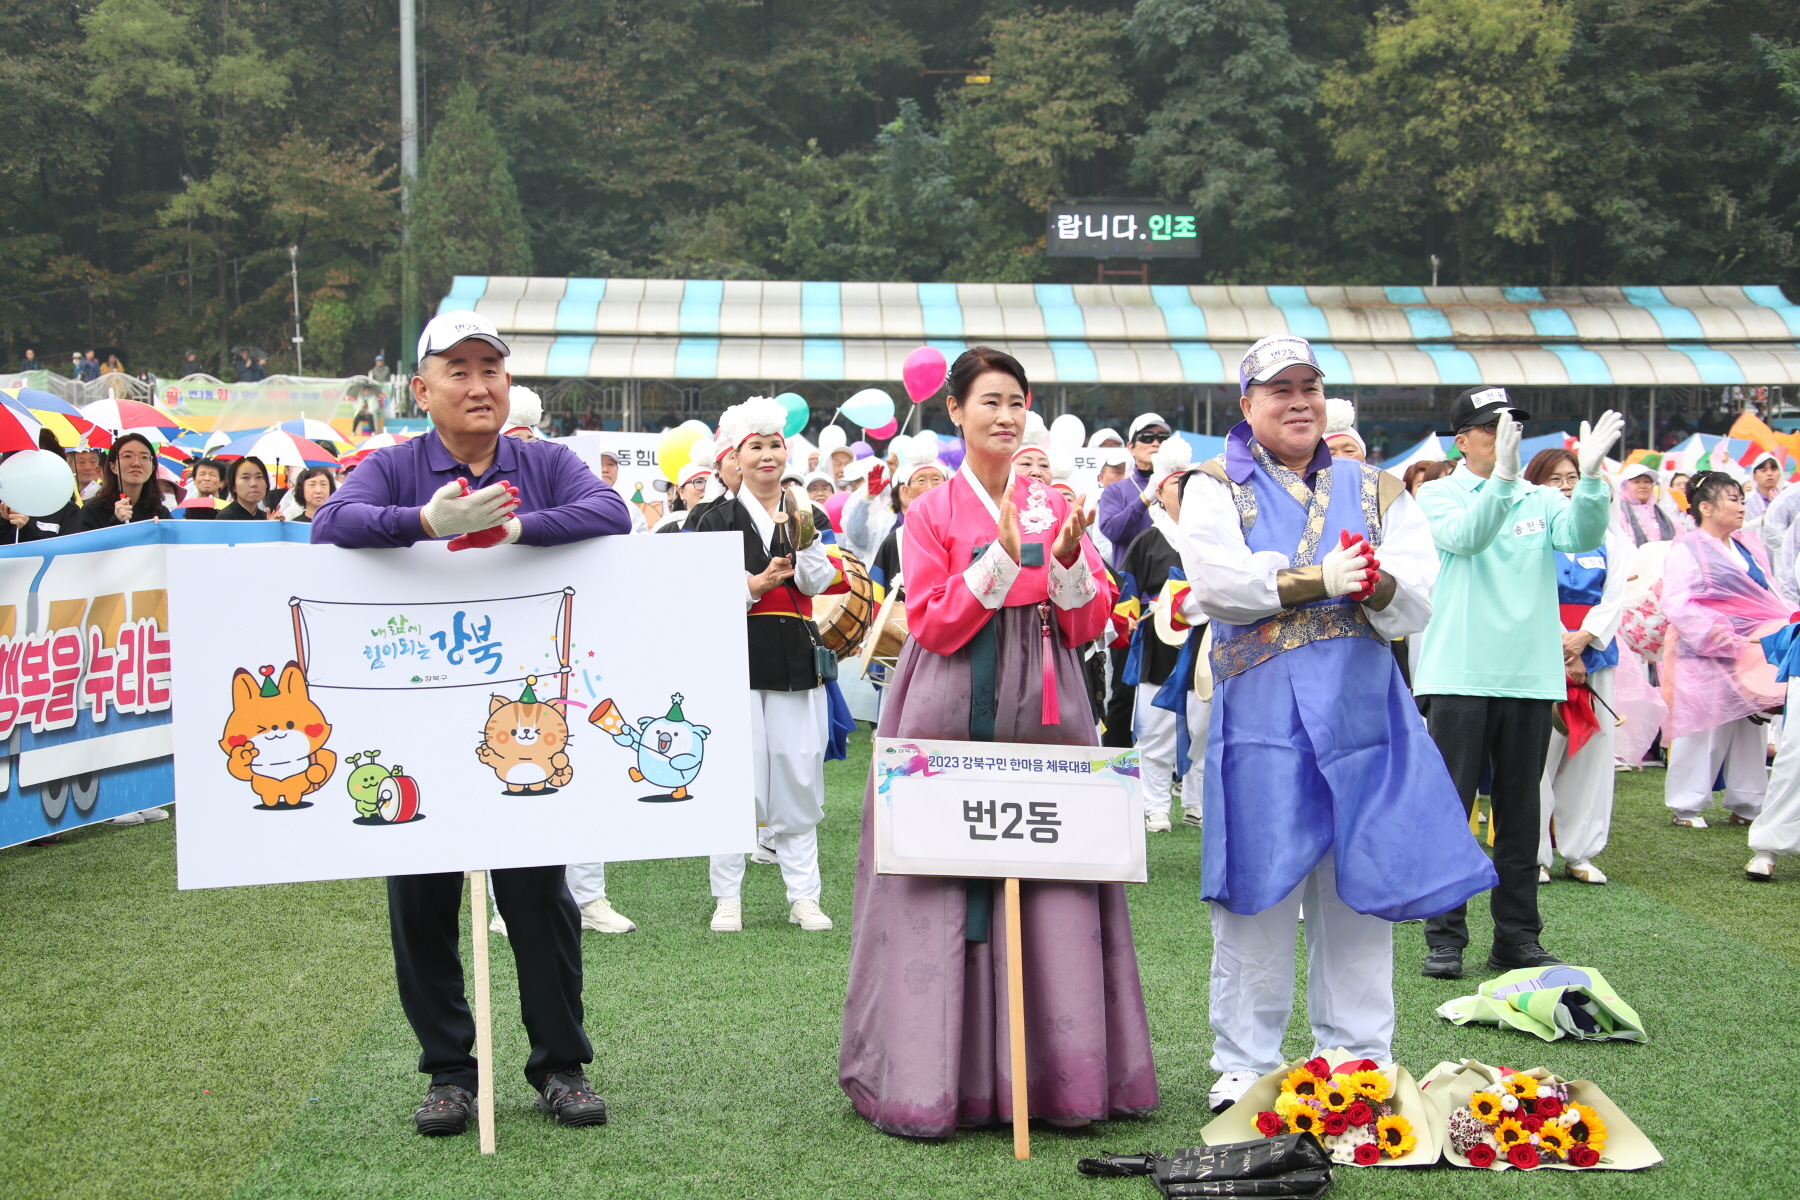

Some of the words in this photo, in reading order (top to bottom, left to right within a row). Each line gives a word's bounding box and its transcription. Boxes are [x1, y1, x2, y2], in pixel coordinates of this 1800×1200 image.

[1058, 214, 1146, 240] 랍니다.
[1149, 214, 1197, 240] 인조
[430, 611, 502, 675] 강북
[85, 624, 171, 714] 누리는
[928, 755, 959, 769] 2023
[963, 756, 1007, 771] 강북구민
[1010, 758, 1043, 772] 한마음
[1046, 759, 1091, 774] 체육대회
[963, 800, 1062, 843] 번2동
